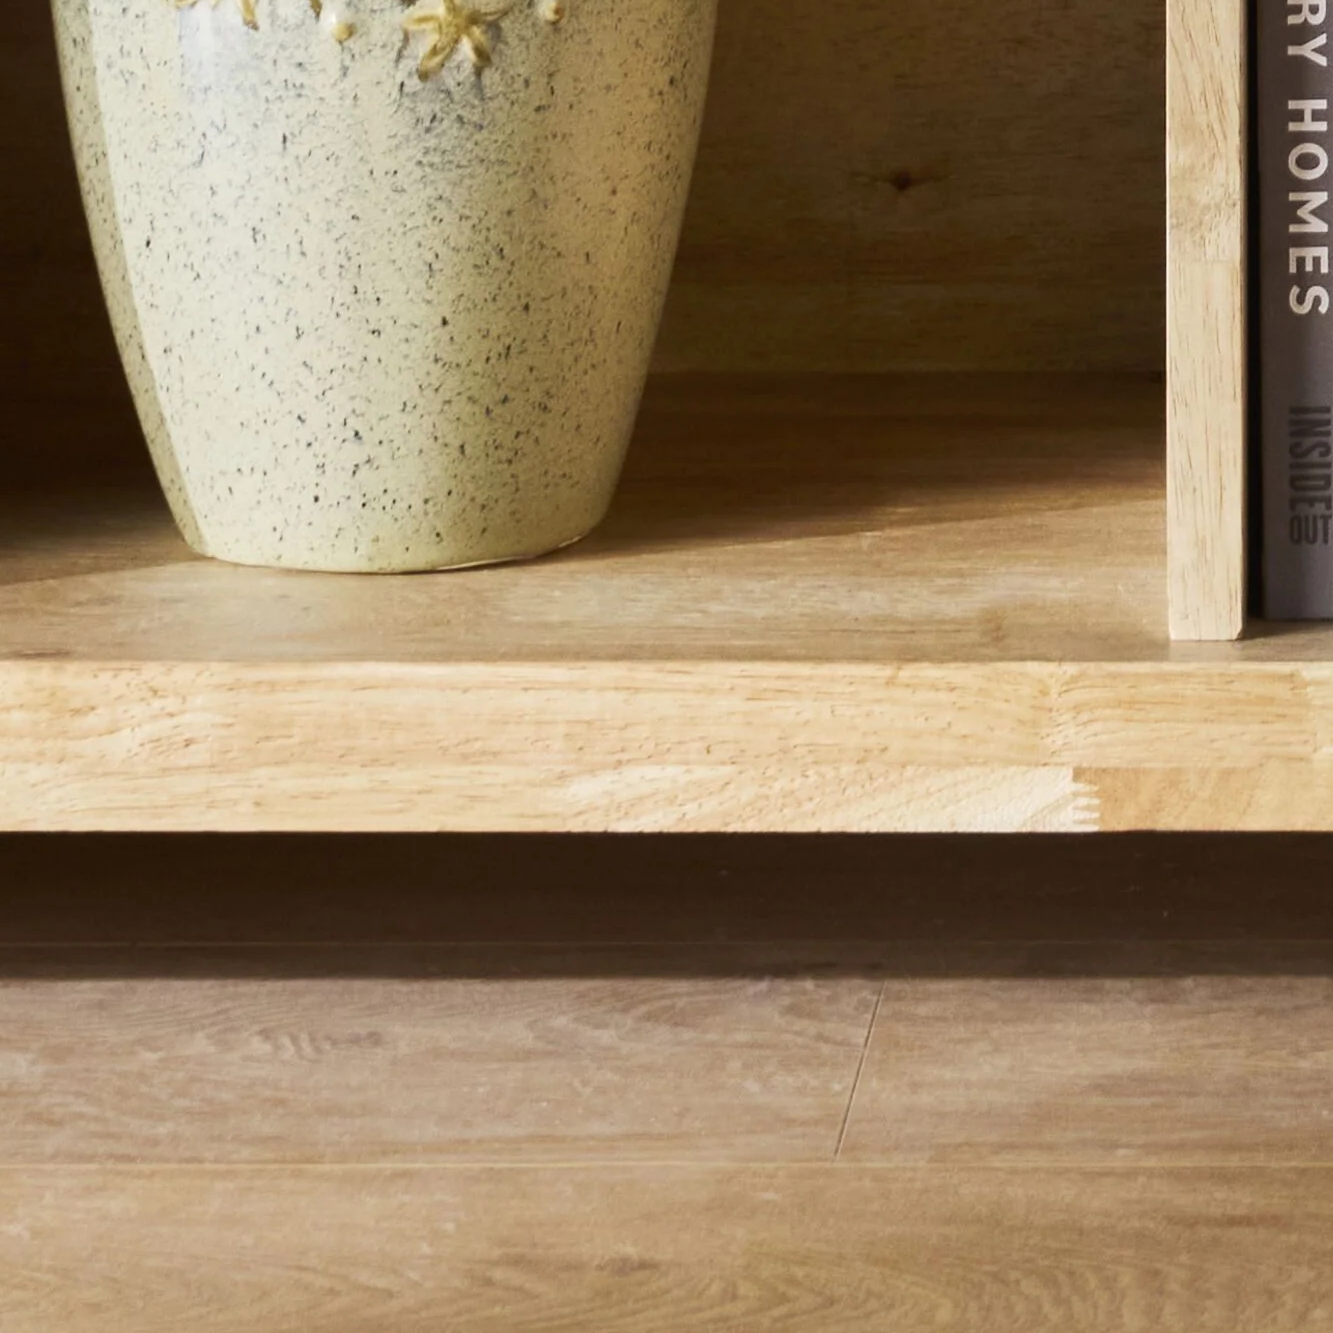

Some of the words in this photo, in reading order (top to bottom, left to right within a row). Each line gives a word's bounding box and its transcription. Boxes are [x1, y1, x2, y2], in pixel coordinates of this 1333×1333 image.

[1287, 98, 1331, 316] HOMES
[1289, 406, 1333, 511] INSIDE
[1289, 513, 1333, 546] OUT
